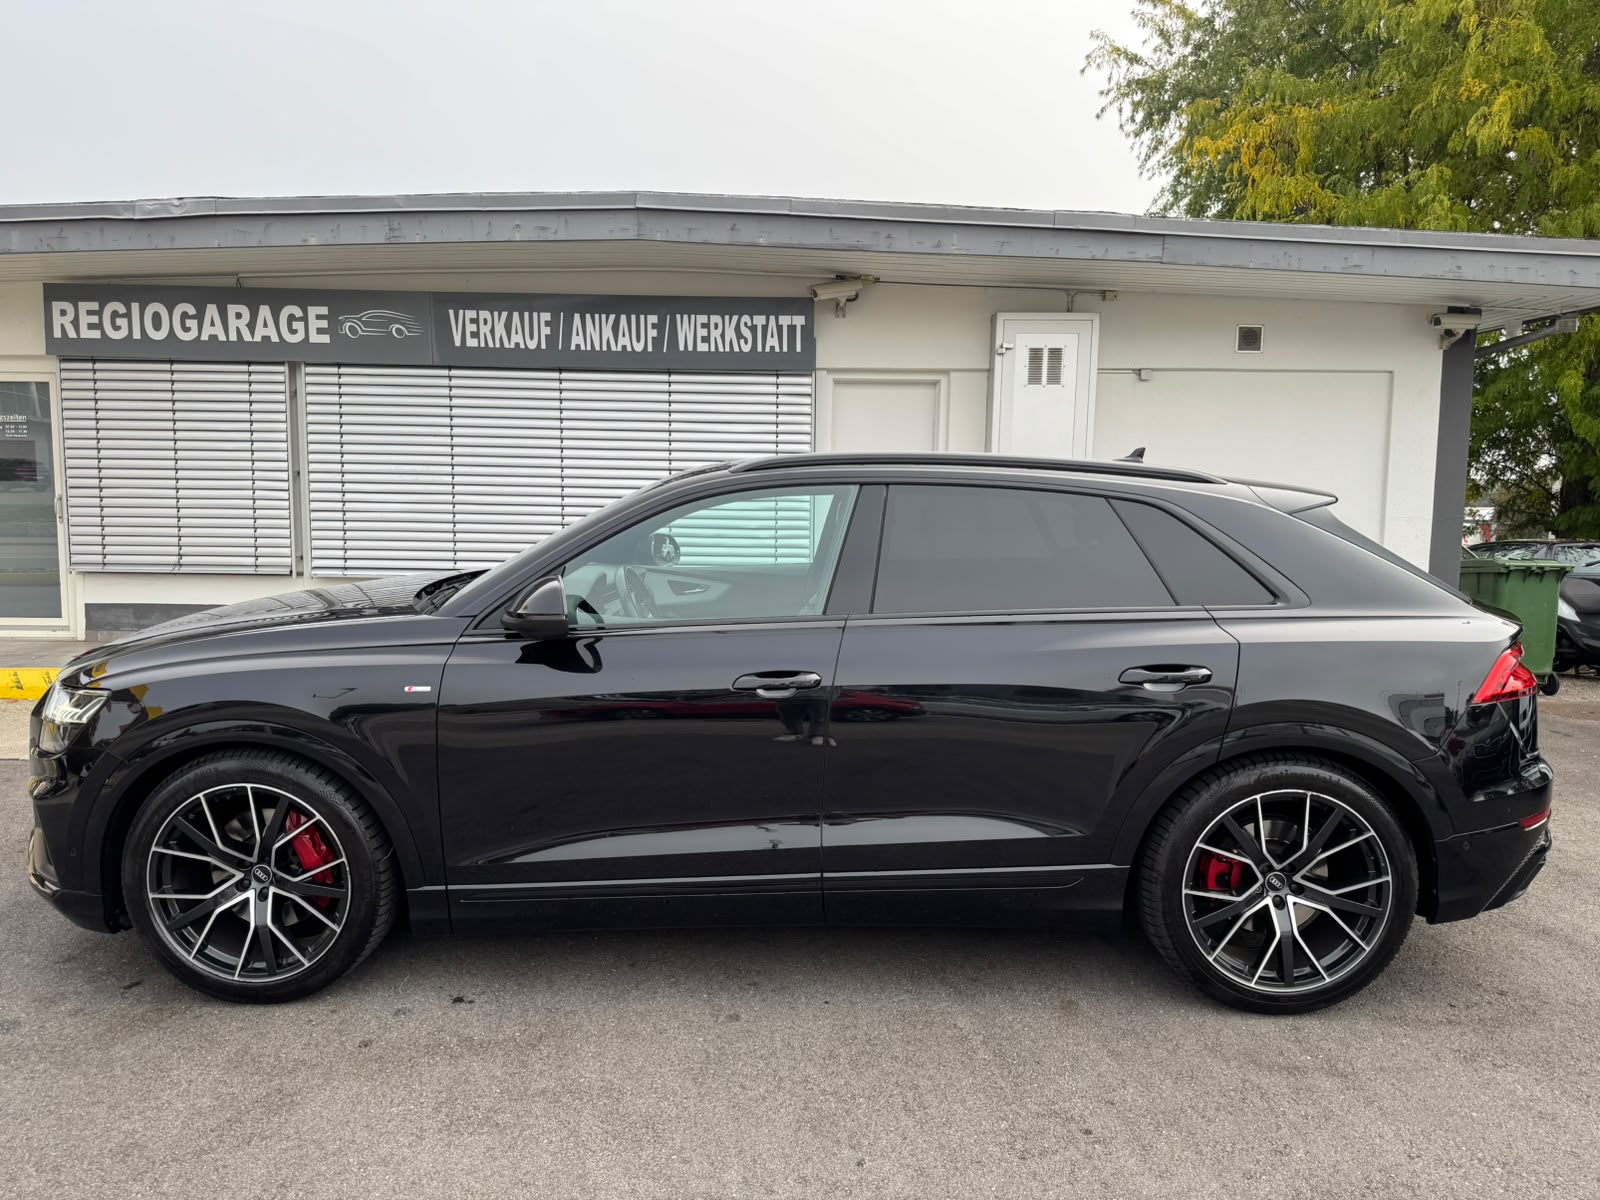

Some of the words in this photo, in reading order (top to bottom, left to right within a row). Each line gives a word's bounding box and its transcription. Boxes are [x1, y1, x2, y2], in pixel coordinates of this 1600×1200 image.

[51, 301, 331, 344] REGIOGARAGE
[448, 309, 552, 350] VERKAUF
[558, 312, 564, 351] /
[570, 313, 659, 353] ANKAUF
[663, 314, 670, 353] /
[675, 314, 806, 353] WERKSTATT
